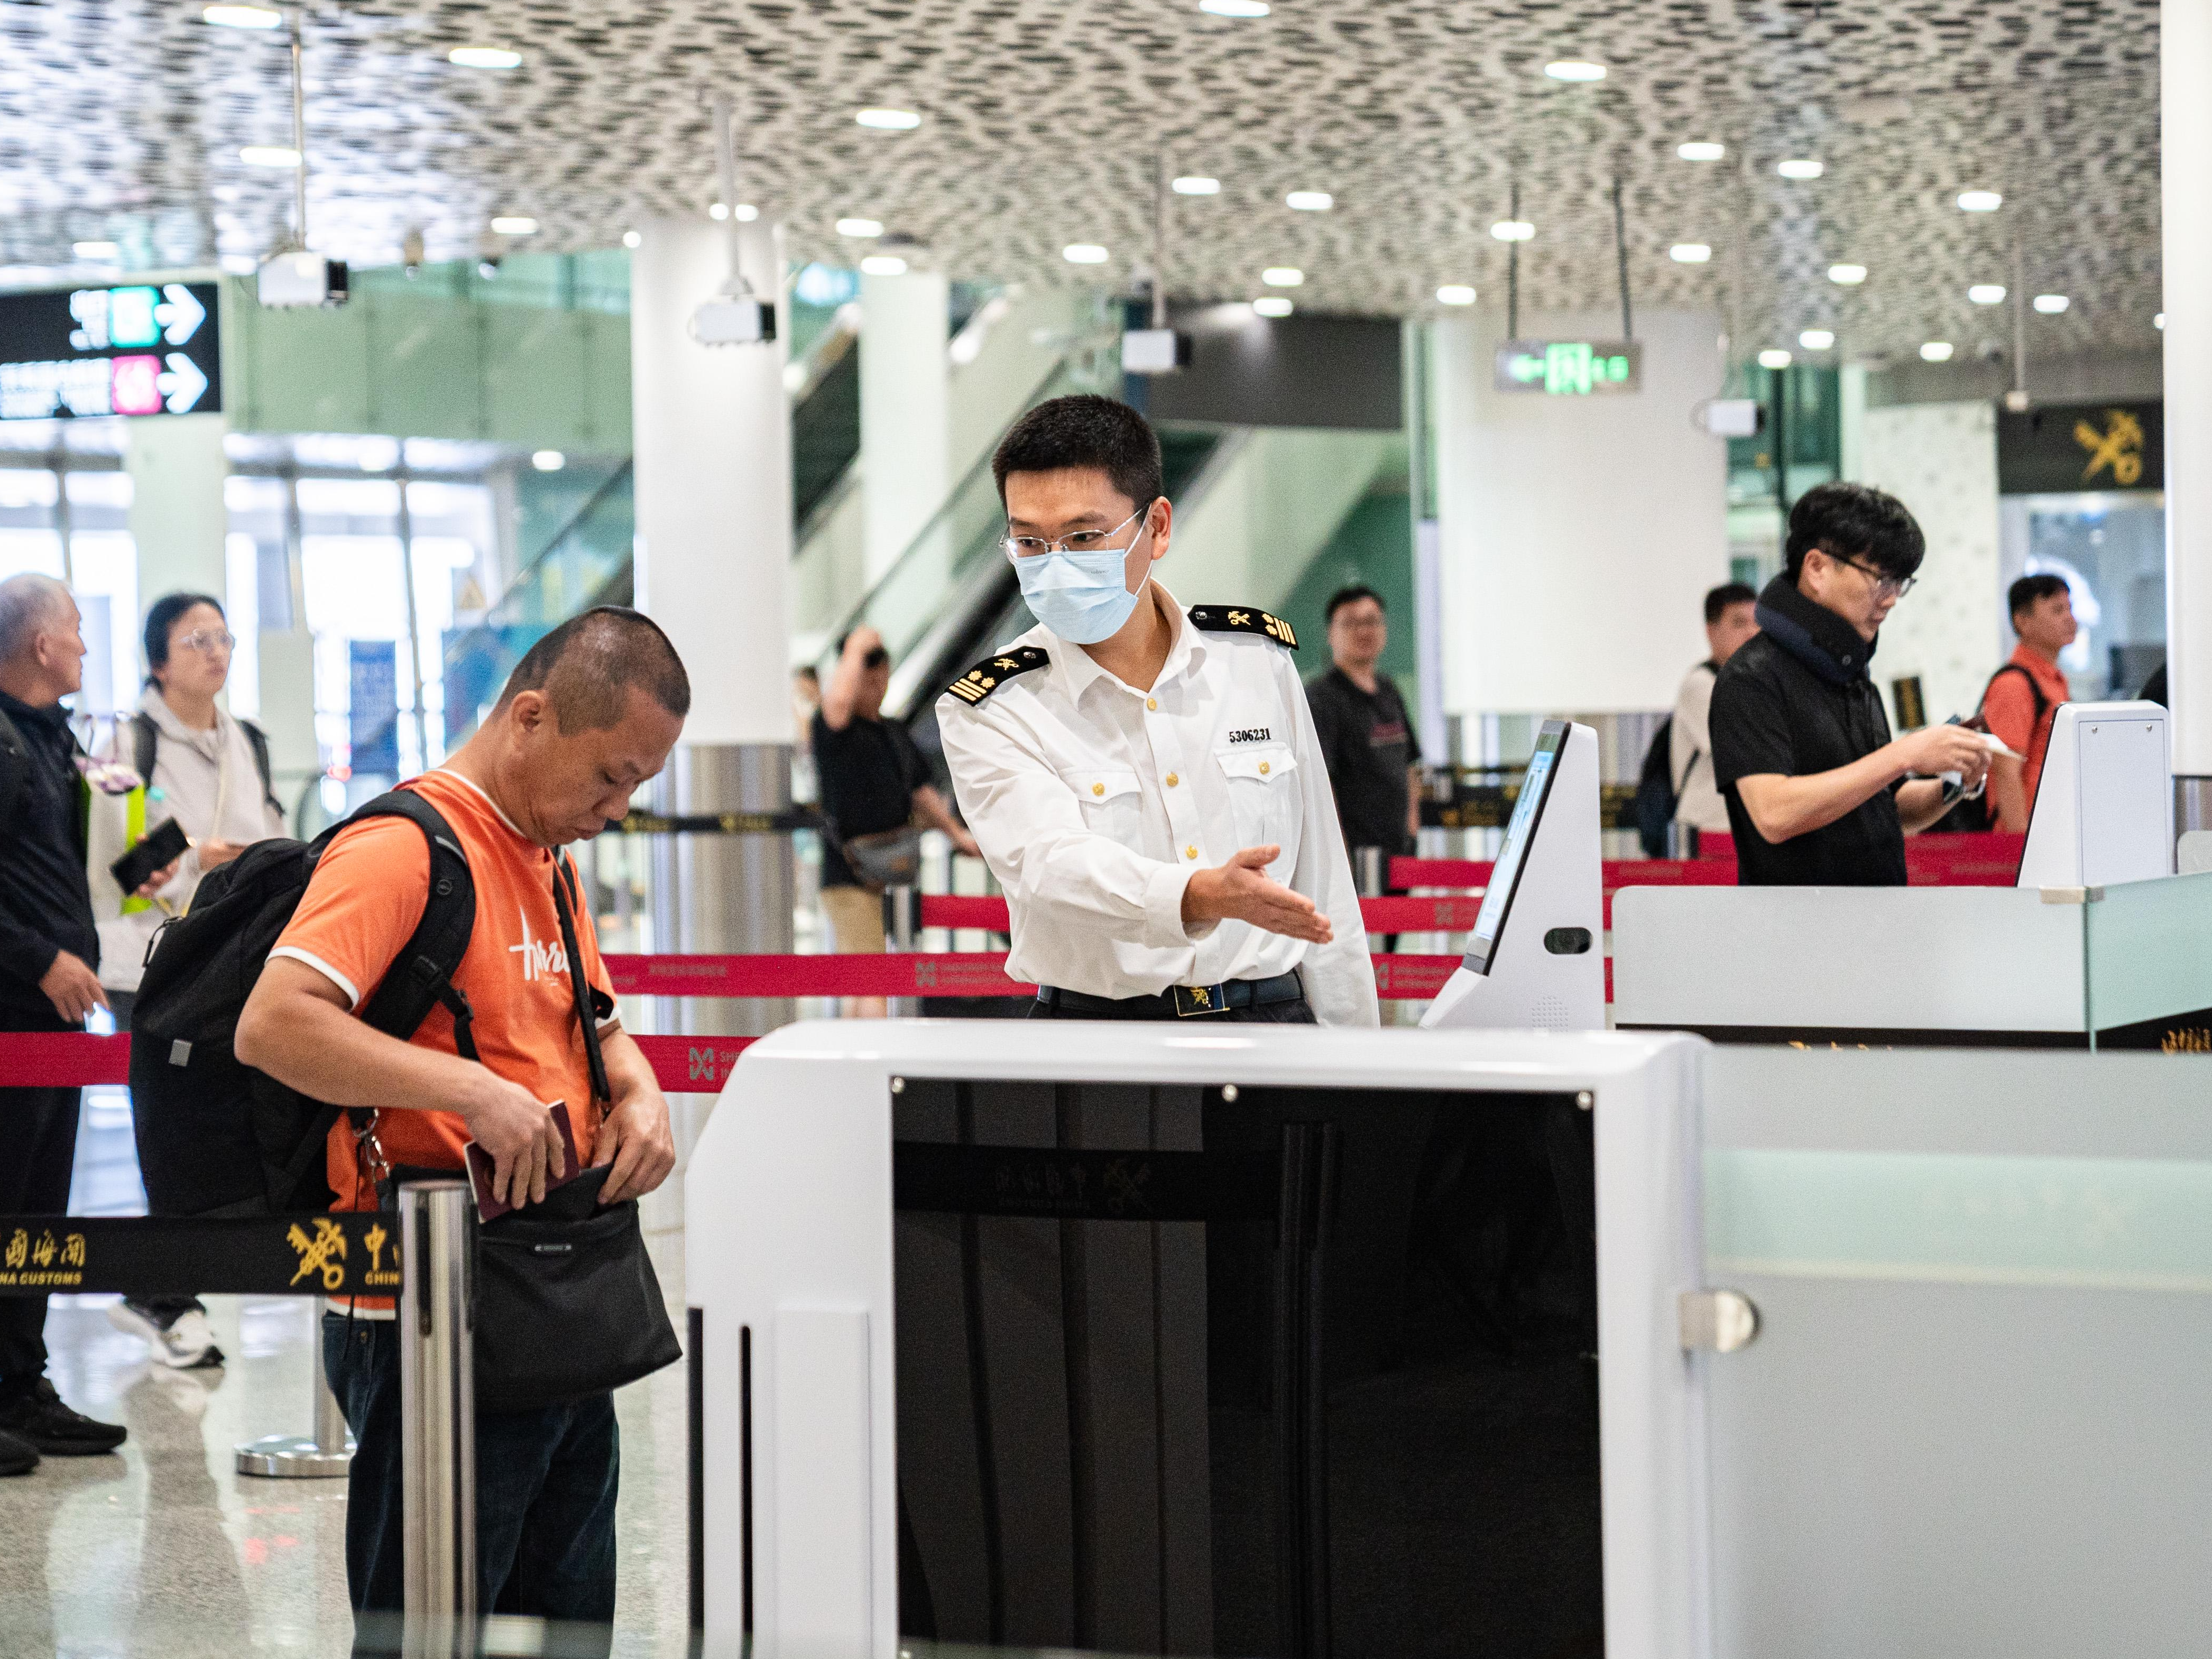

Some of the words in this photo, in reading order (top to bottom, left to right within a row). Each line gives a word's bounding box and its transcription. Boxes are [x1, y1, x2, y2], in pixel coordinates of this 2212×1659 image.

[1229, 727, 1271, 743] 5306231
[364, 1222, 400, 1271] 中
[0, 1271, 17, 1285] NA
[19, 1271, 82, 1285] CUSTOMS
[364, 1271, 400, 1285] CHIN
